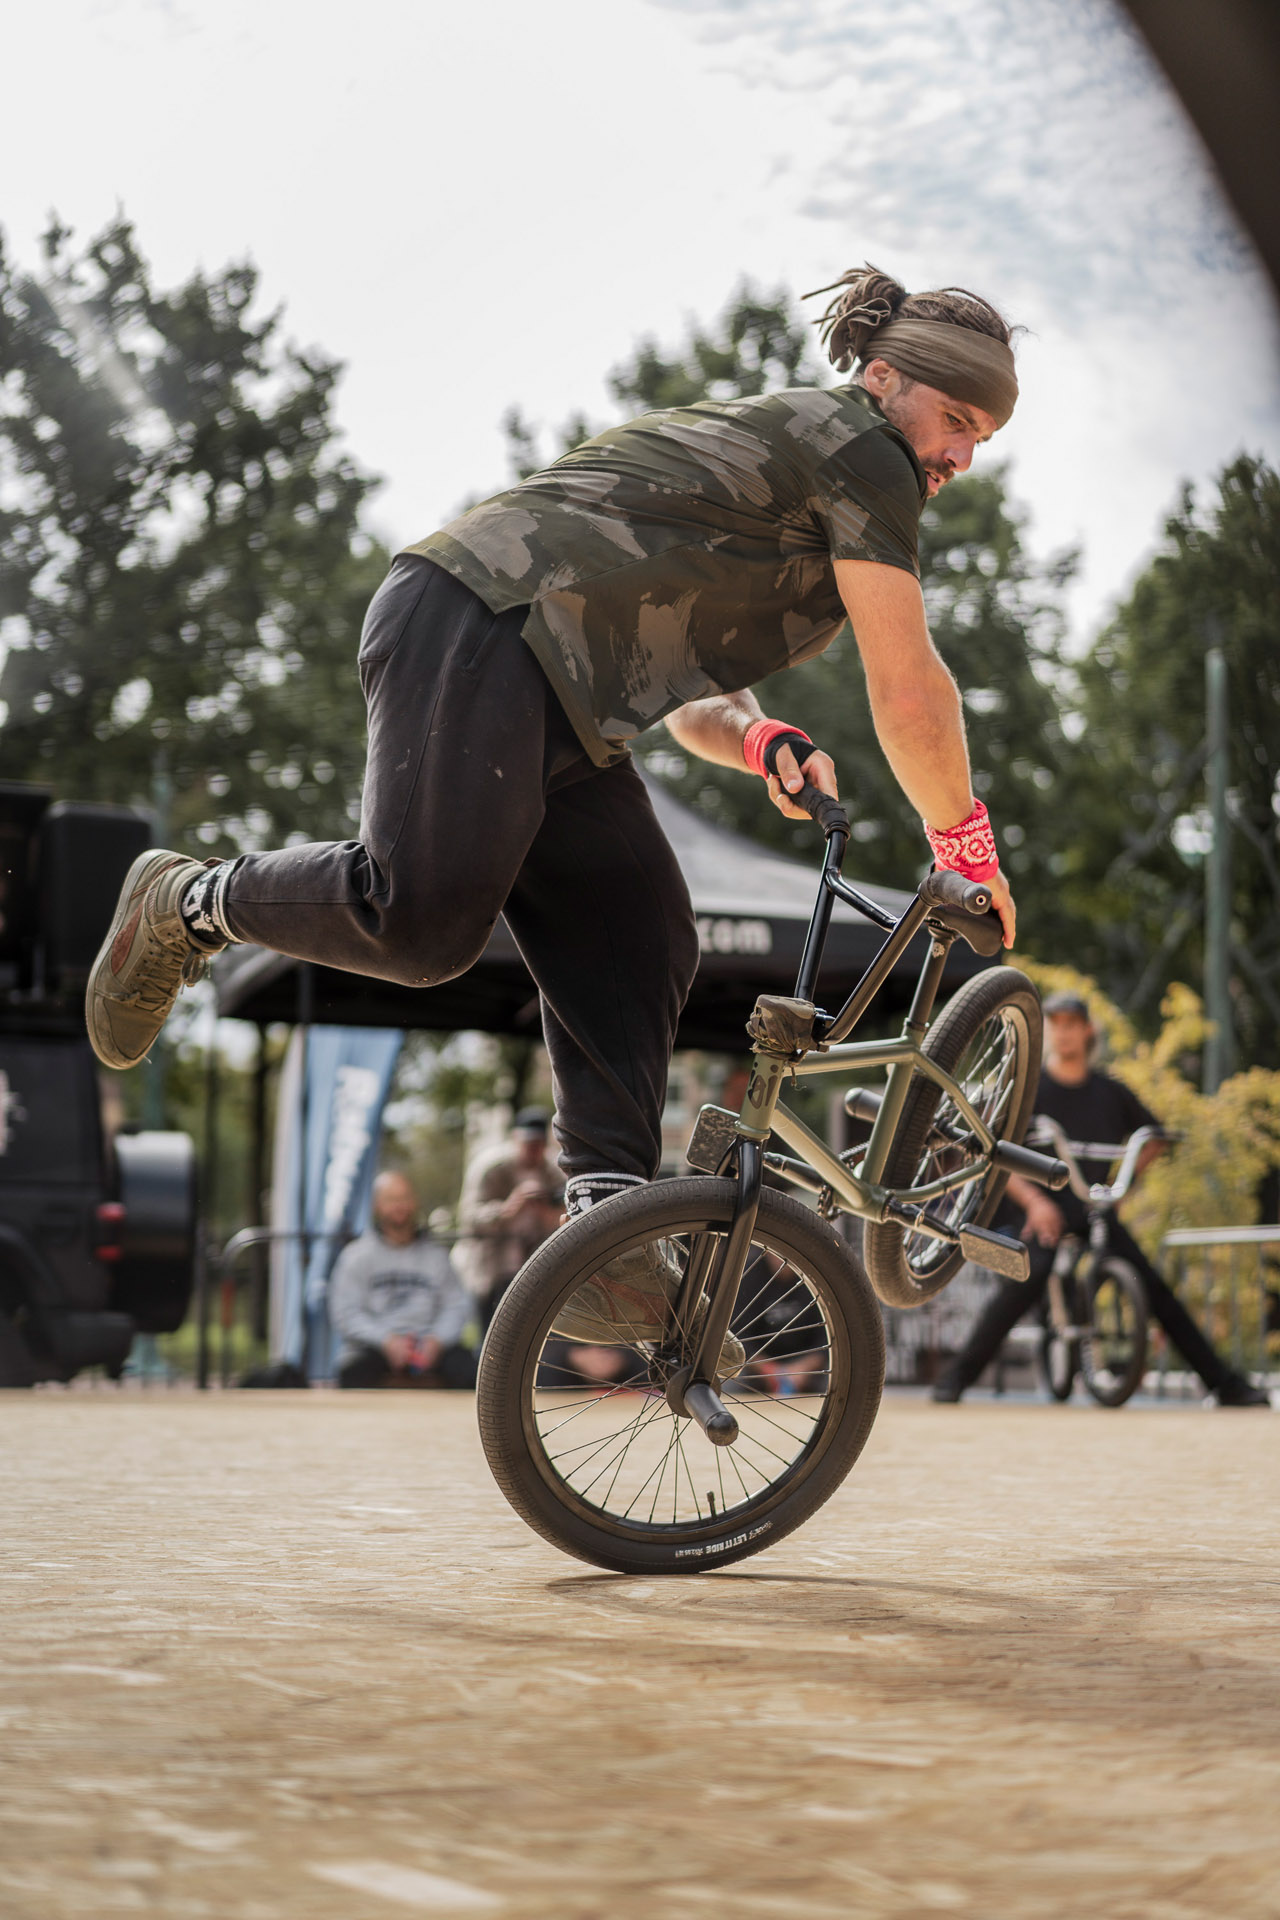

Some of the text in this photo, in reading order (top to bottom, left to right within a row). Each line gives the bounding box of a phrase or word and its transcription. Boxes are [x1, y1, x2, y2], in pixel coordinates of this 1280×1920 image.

[725, 1539, 733, 1550] IT
[733, 1533, 747, 1546] LET
[705, 1542, 724, 1554] RIDE
